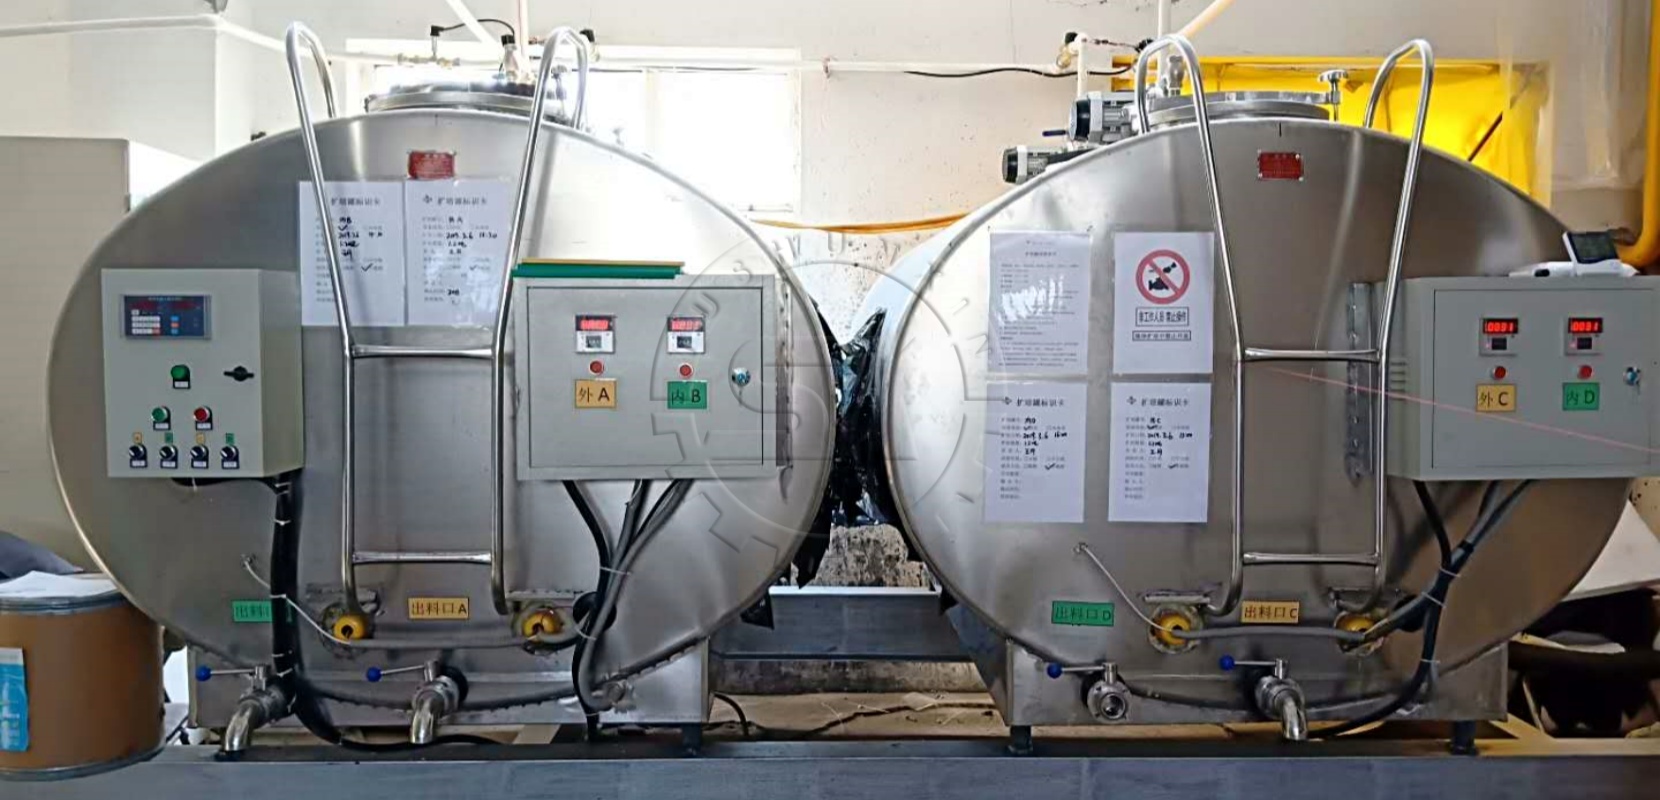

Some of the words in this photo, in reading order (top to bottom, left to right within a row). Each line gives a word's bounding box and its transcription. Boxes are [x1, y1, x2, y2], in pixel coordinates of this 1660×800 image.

[578, 387, 593, 402] 外
[598, 388, 610, 402] A
[671, 389, 684, 405] 内
[692, 389, 702, 402] B
[1479, 391, 1493, 408] 外
[1498, 392, 1509, 406] C
[1567, 390, 1579, 405] 内
[1584, 390, 1595, 404] D
[411, 601, 467, 616] 出料口A
[1055, 606, 1112, 622] 出料口D
[1244, 604, 1298, 619] 出料口C
